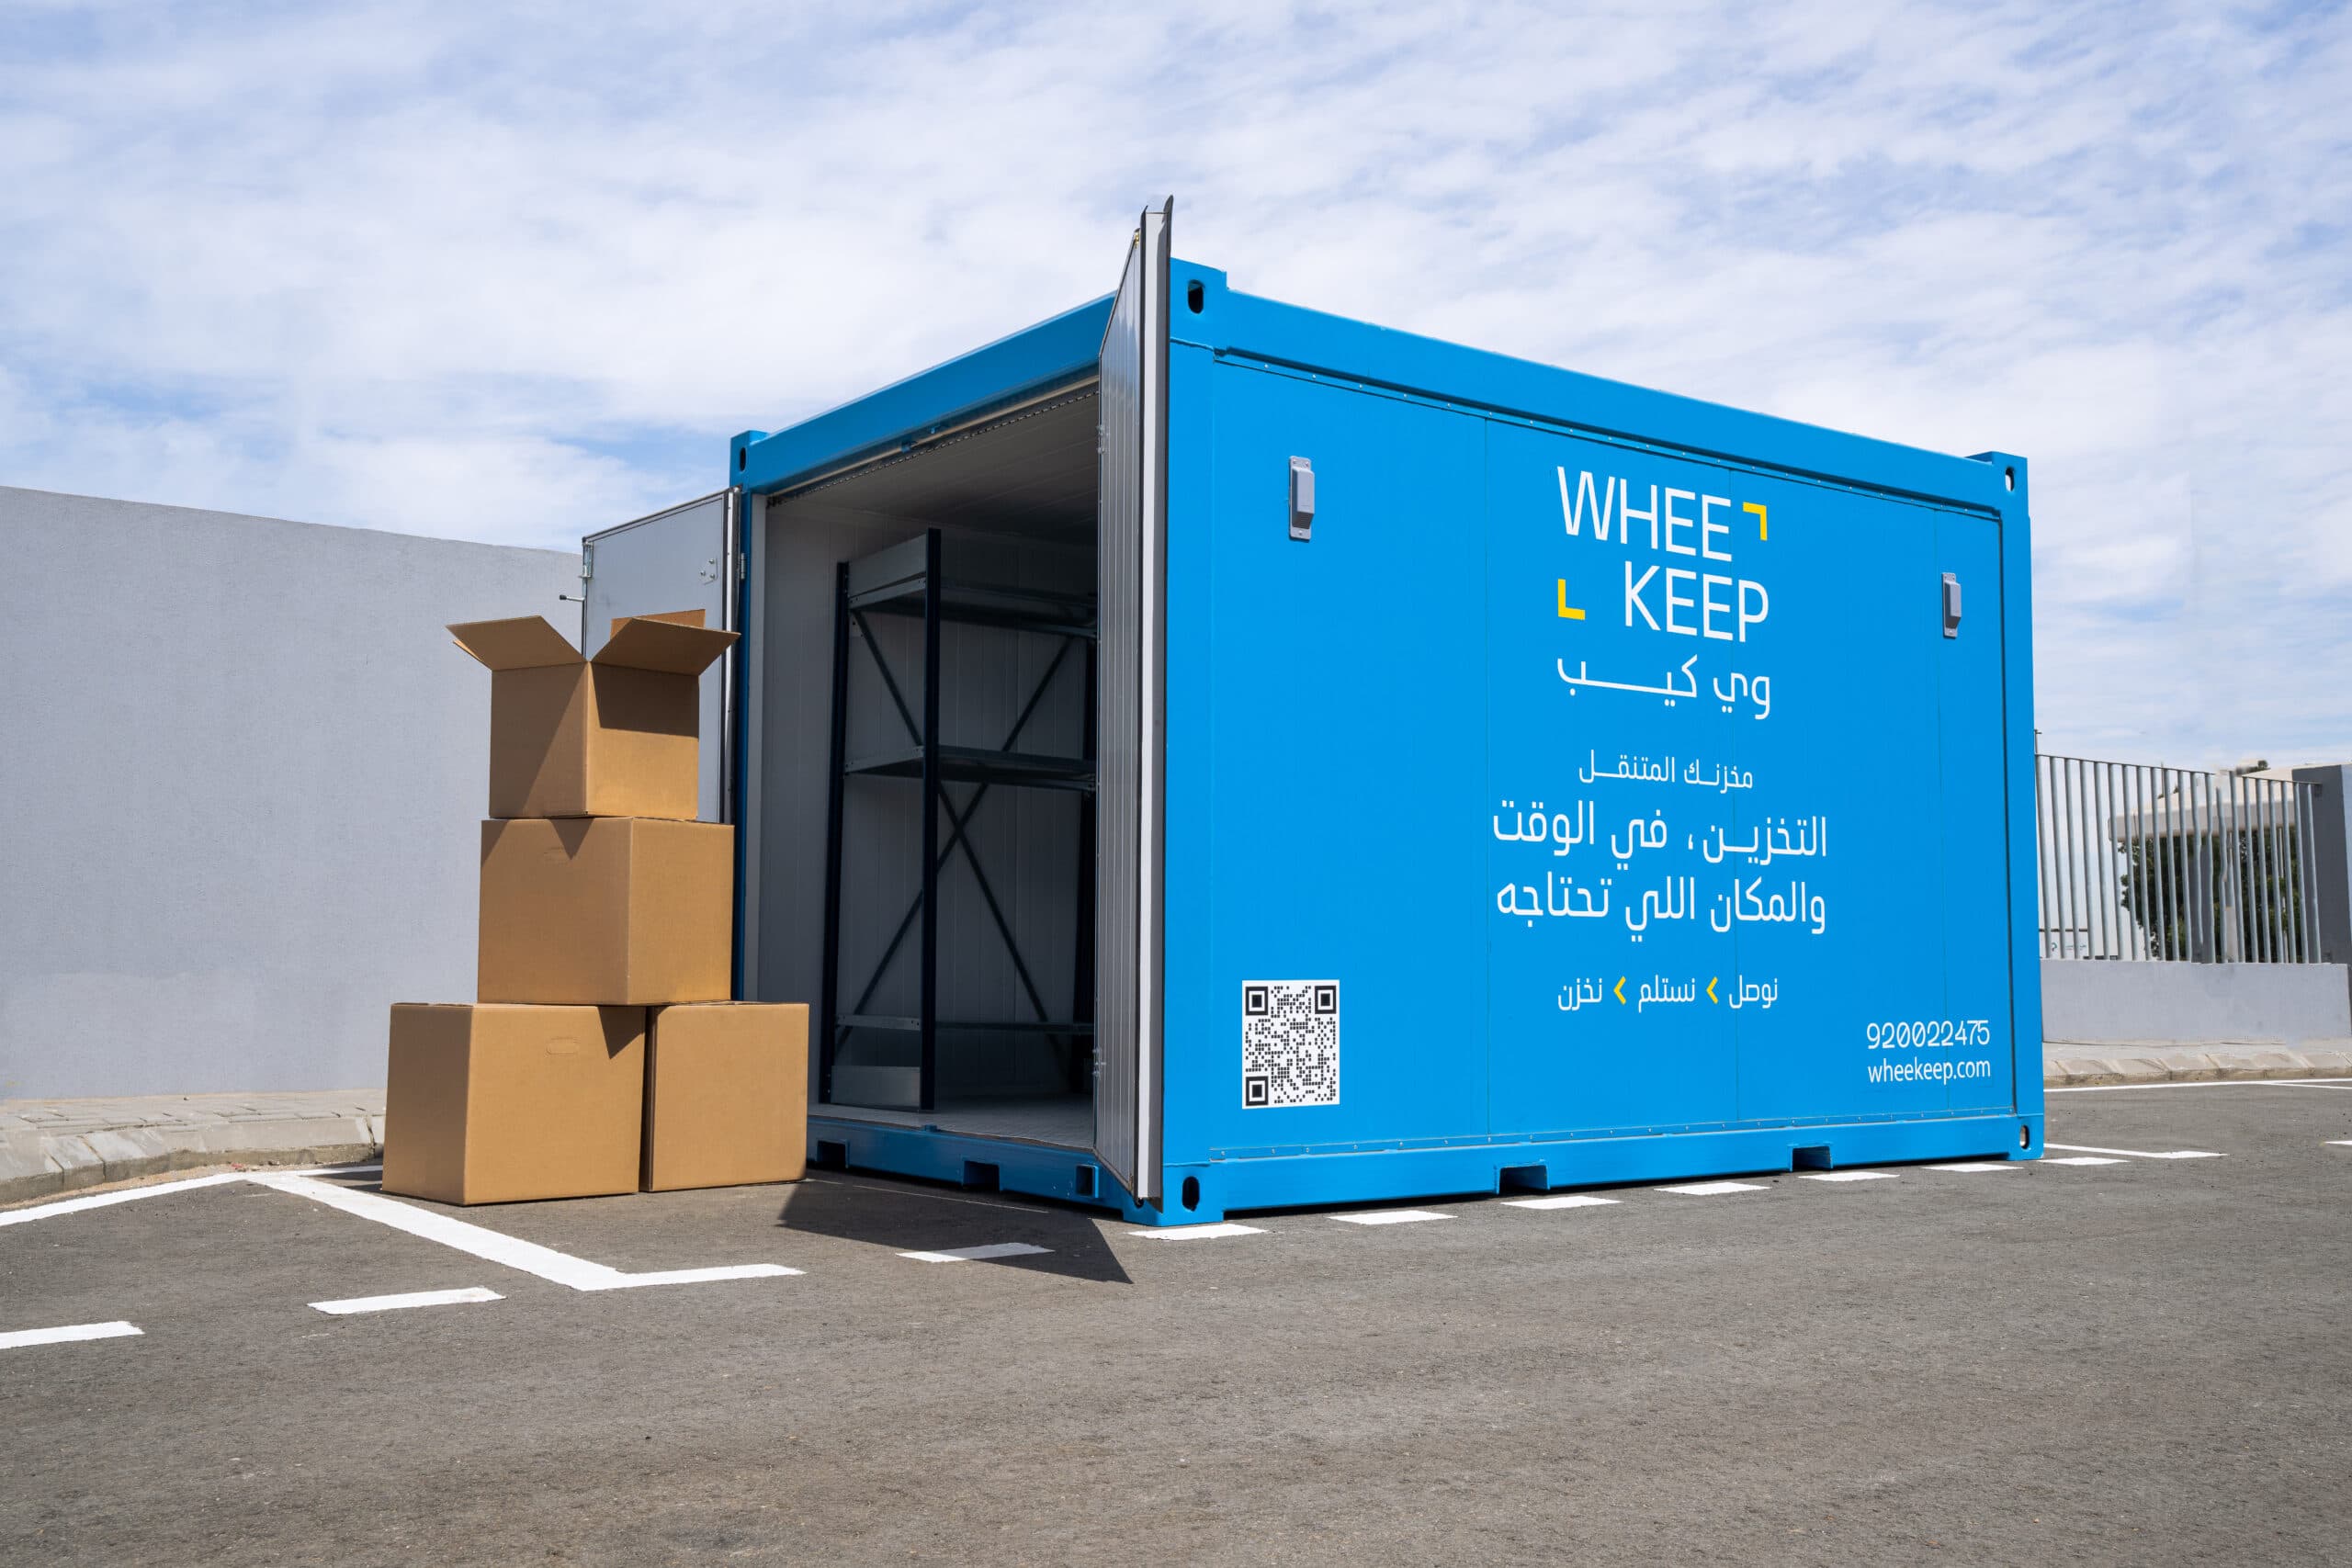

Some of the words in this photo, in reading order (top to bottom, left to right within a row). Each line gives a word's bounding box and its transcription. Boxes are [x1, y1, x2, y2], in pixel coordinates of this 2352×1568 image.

[1557, 467, 1732, 562] WHEE
[1625, 560, 1769, 642] KEEP
[1557, 655, 1698, 707] كيب
[1713, 671, 1770, 720] وي
[1578, 749, 1676, 784] المتنقل
[1684, 759, 1753, 795] مخزنك
[1493, 799, 1595, 857] الوقت
[1611, 808, 1668, 871] في
[1497, 871, 1612, 928] تحتاجه
[1625, 875, 1695, 942] اللي
[1710, 876, 1826, 935] والمكان
[1557, 976, 1603, 1011] نخزن
[1638, 974, 1696, 1013] نستلم
[1728, 974, 1779, 1010] نوصل
[1866, 1020, 1991, 1050] 920022475
[1867, 1056, 1992, 1086] wheekeep.com
